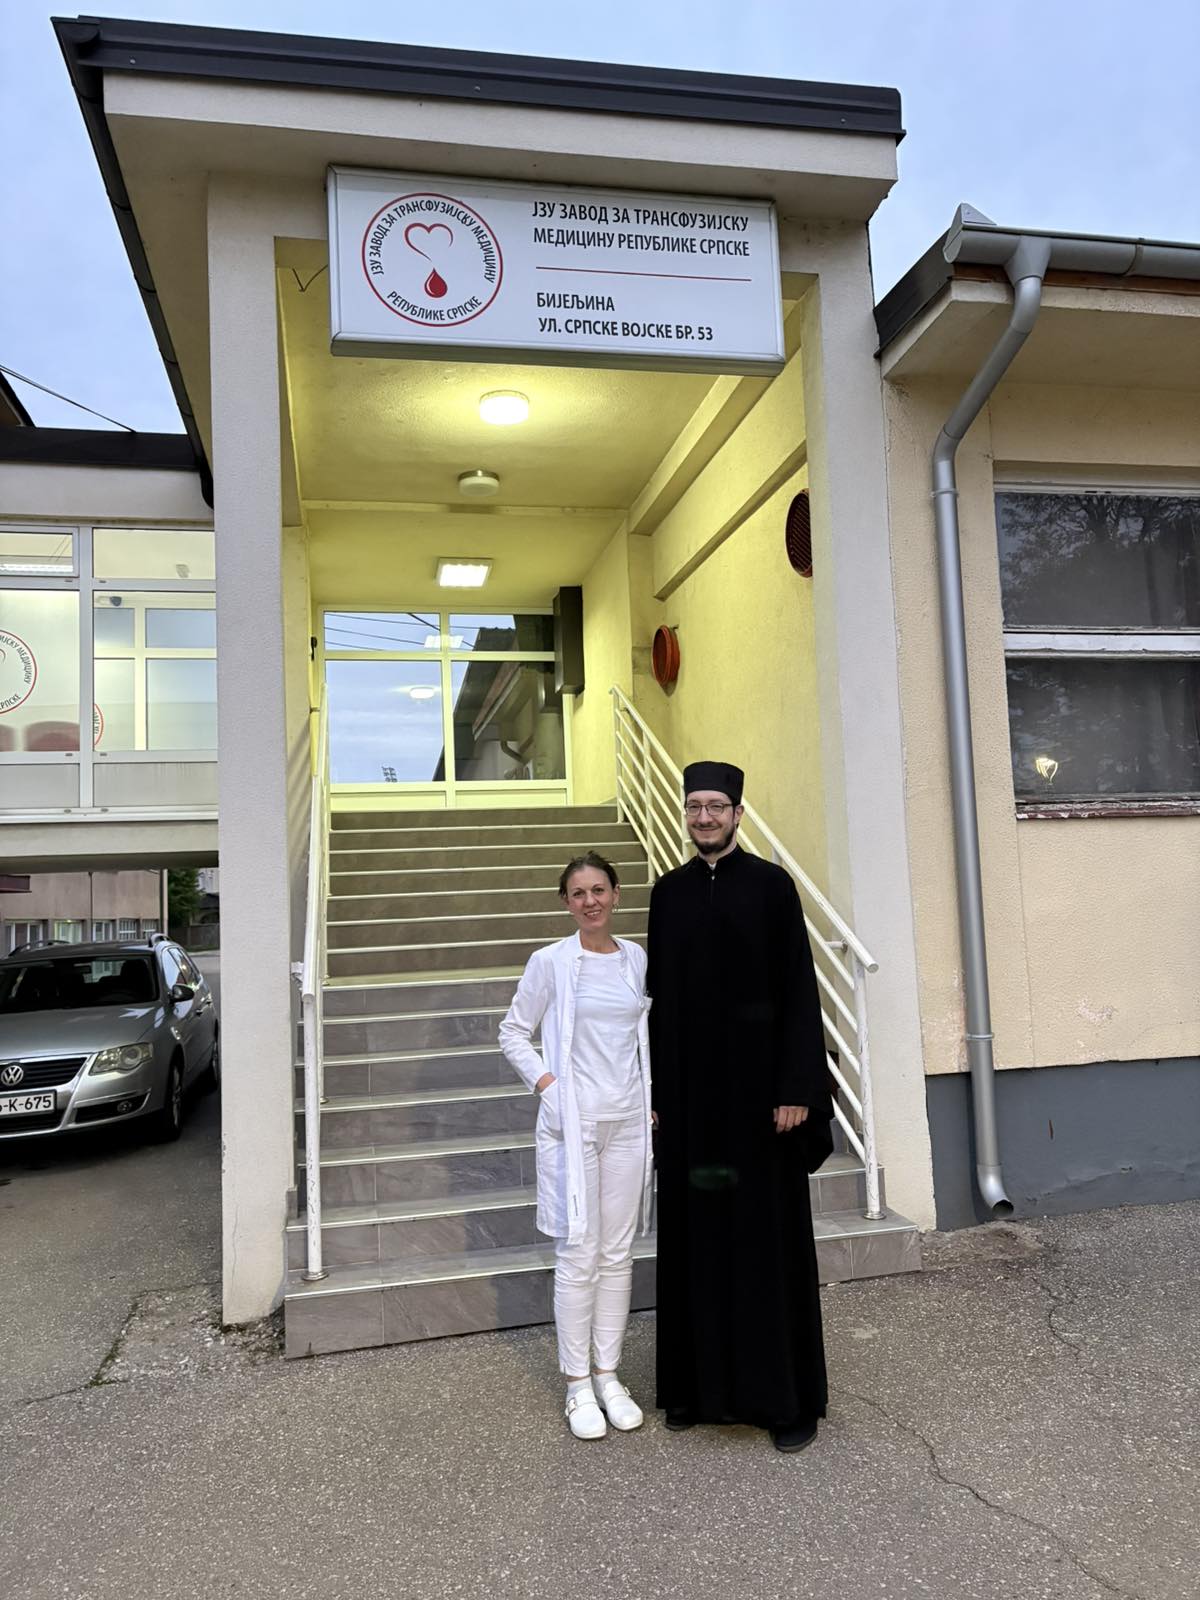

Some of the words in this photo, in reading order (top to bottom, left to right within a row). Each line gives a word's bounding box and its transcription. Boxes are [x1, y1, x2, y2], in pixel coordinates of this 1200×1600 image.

[381, 213, 398, 228] ЗА
[392, 199, 477, 227] ТРАНСФУЗИЈСКУ
[532, 201, 556, 218] ЈЗУ
[559, 203, 609, 225] ЗАВОД
[612, 207, 631, 224] ЗА
[633, 208, 749, 232] ТРАНСФУЗИЈСКУ
[369, 223, 391, 258] ЗАВОД
[471, 225, 497, 284] МЕДИЦИНУ
[533, 227, 615, 249] МЕДИЦИНУ
[618, 233, 697, 254] РЕПУБЛИКЕ
[699, 238, 750, 257] СРПСКЕ
[369, 259, 385, 276] ЈЗУ
[387, 291, 446, 321] РЕПУБЛИКЕ
[446, 295, 483, 320] СРПСКЕ
[536, 292, 615, 312] БИЈЕЉИНА
[538, 317, 562, 333] УЛ.
[564, 319, 619, 337] СРПСКЕ
[621, 321, 673, 339] ВОЈСКЕ
[675, 324, 695, 340] БР.
[697, 326, 714, 341] 53
